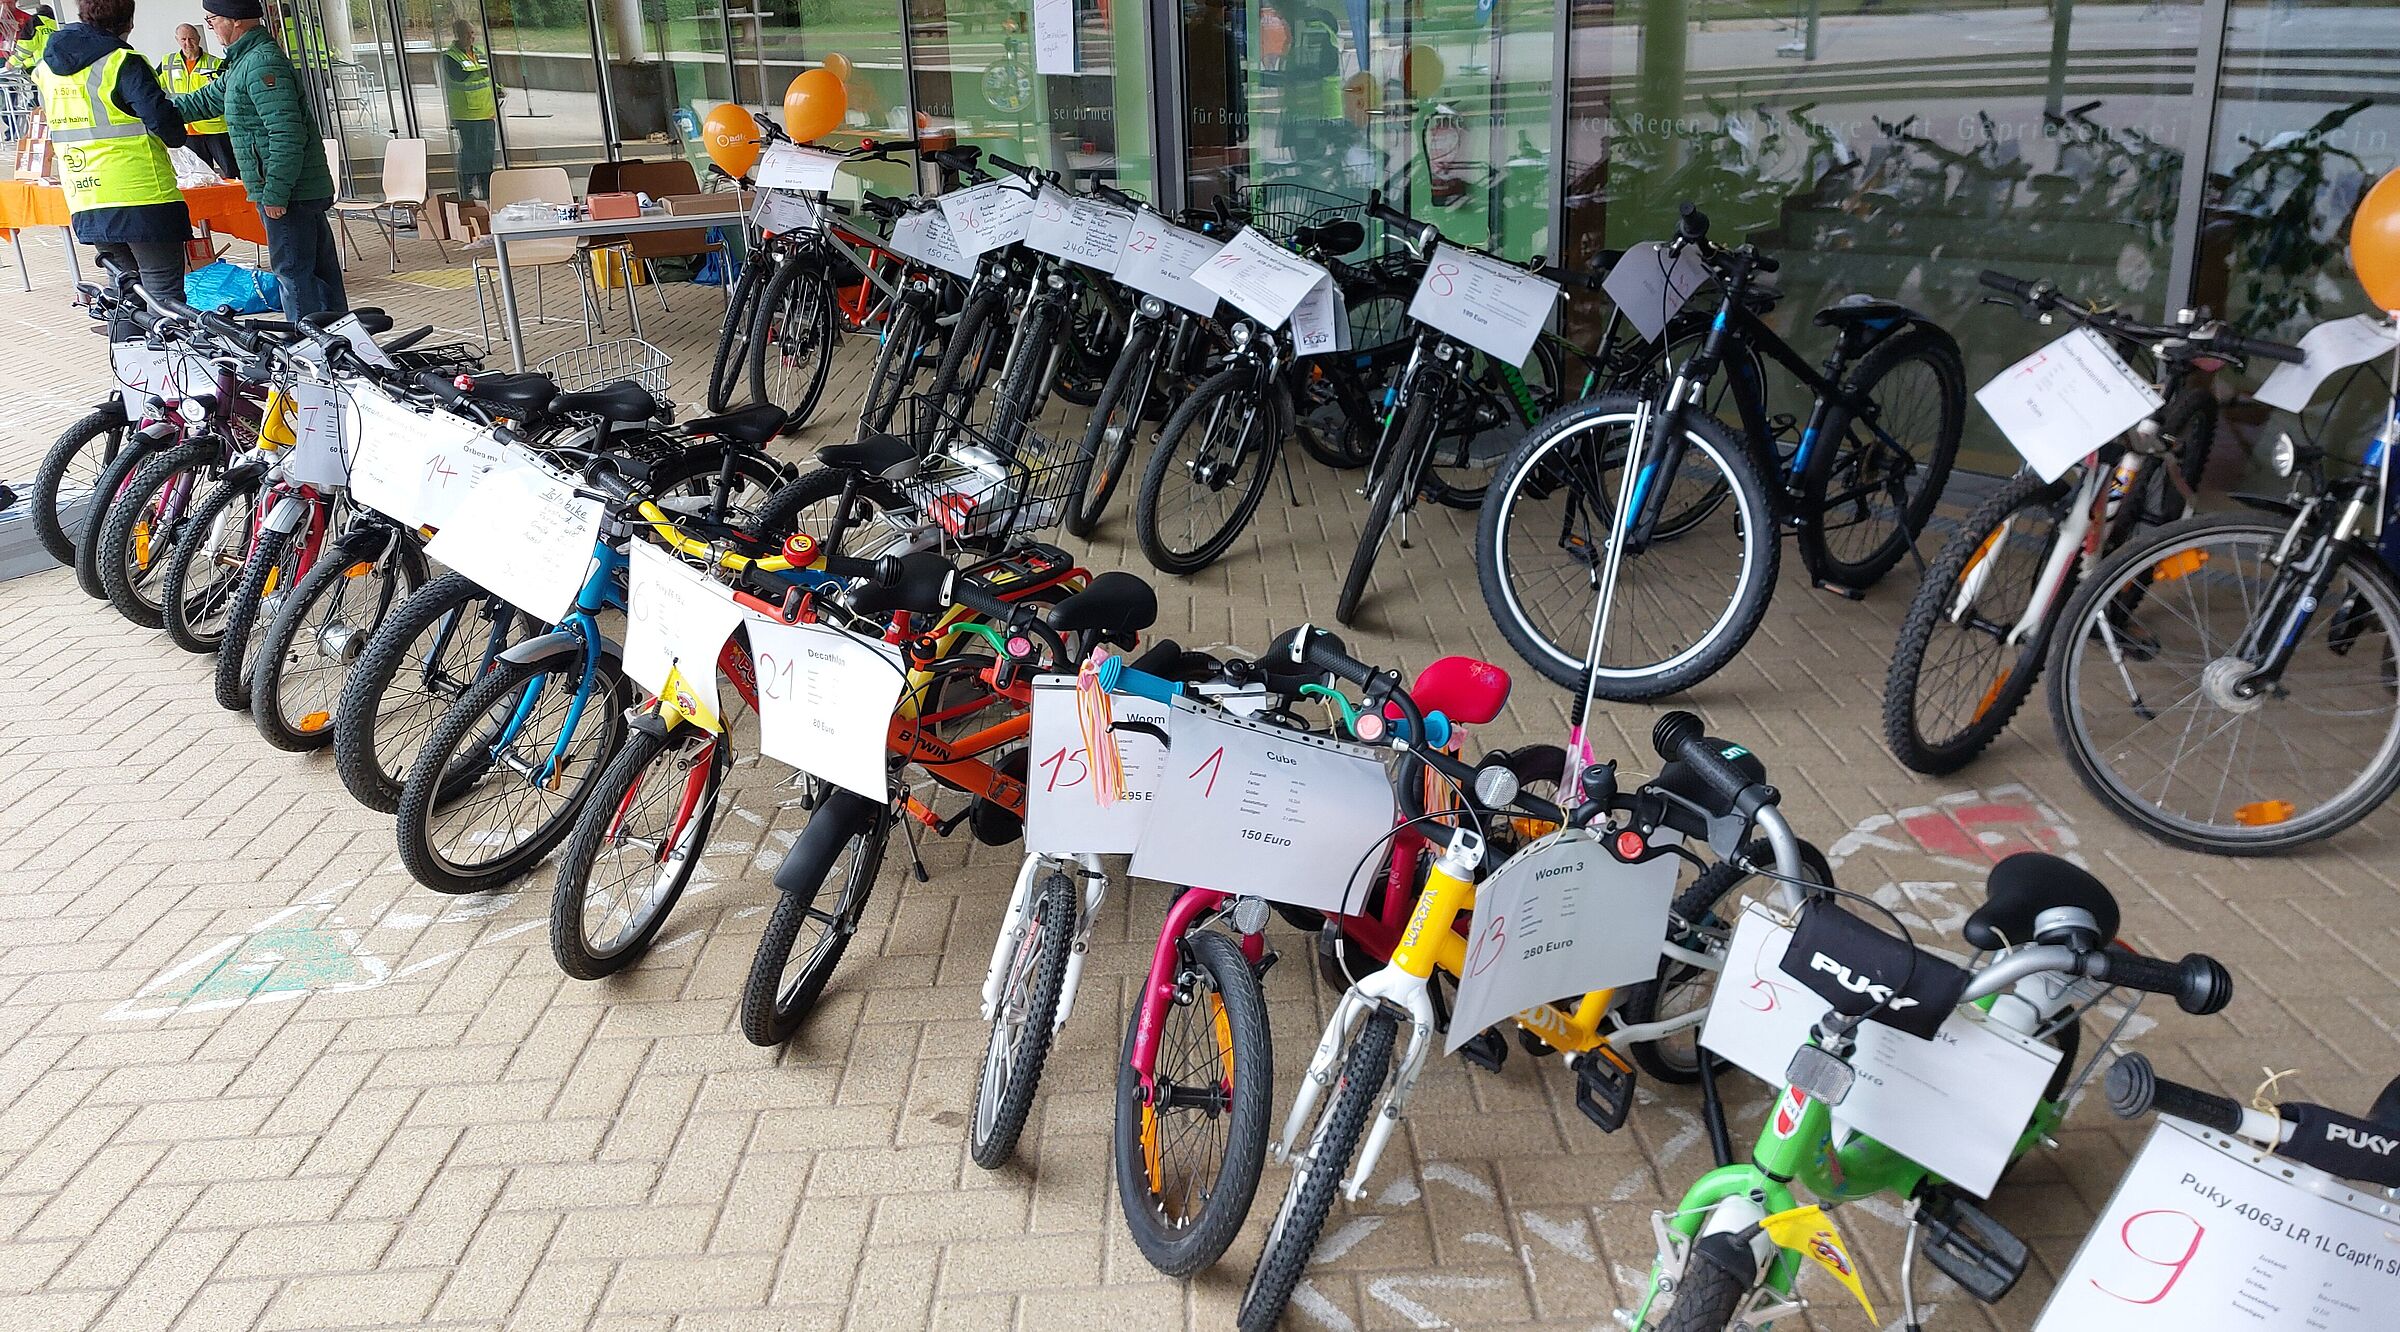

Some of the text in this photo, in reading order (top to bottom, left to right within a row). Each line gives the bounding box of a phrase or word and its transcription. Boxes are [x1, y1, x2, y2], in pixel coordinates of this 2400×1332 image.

[1054, 106, 1070, 120] sei
[1073, 104, 1087, 120] du
[1192, 106, 1213, 124] für
[1633, 112, 1701, 140] Regen
[764, 152, 779, 168] 4
[75, 176, 102, 189] adfc
[955, 207, 980, 233] 36
[1035, 201, 1062, 223] 33
[1062, 240, 1085, 254] 240
[1128, 230, 1158, 254] 27
[925, 247, 955, 263] 150 Eur
[1167, 271, 1181, 281] Euro
[1428, 262, 1460, 297] 8
[1474, 313, 1488, 326] Euro
[329, 446, 338, 454] 60
[463, 444, 486, 460] Orbea
[426, 453, 458, 489] 14
[807, 648, 846, 667] Decathlon
[759, 653, 794, 702] 21
[821, 721, 835, 735] Euro
[1039, 746, 1089, 793] 15
[1266, 751, 1298, 767] Cube
[1188, 745, 1224, 799] 1
[1120, 791, 1142, 802] 295
[1240, 828, 1292, 848] 150 Euro
[1534, 861, 1585, 883] Woom 3
[1469, 915, 1506, 979] 13
[1522, 938, 1575, 961] 280 Euro
[1809, 950, 1921, 1012] PUKY
[1740, 979, 1800, 1012] 5
[2324, 1121, 2400, 1157] PUKY
[2180, 1171, 2233, 1209] Puky
[2233, 1203, 2284, 1233] 4063
[2285, 1223, 2311, 1245] LR
[2314, 1234, 2332, 1253] 1L
[2334, 1241, 2384, 1272] Capt'n
[2090, 1209, 2206, 1305] 9
